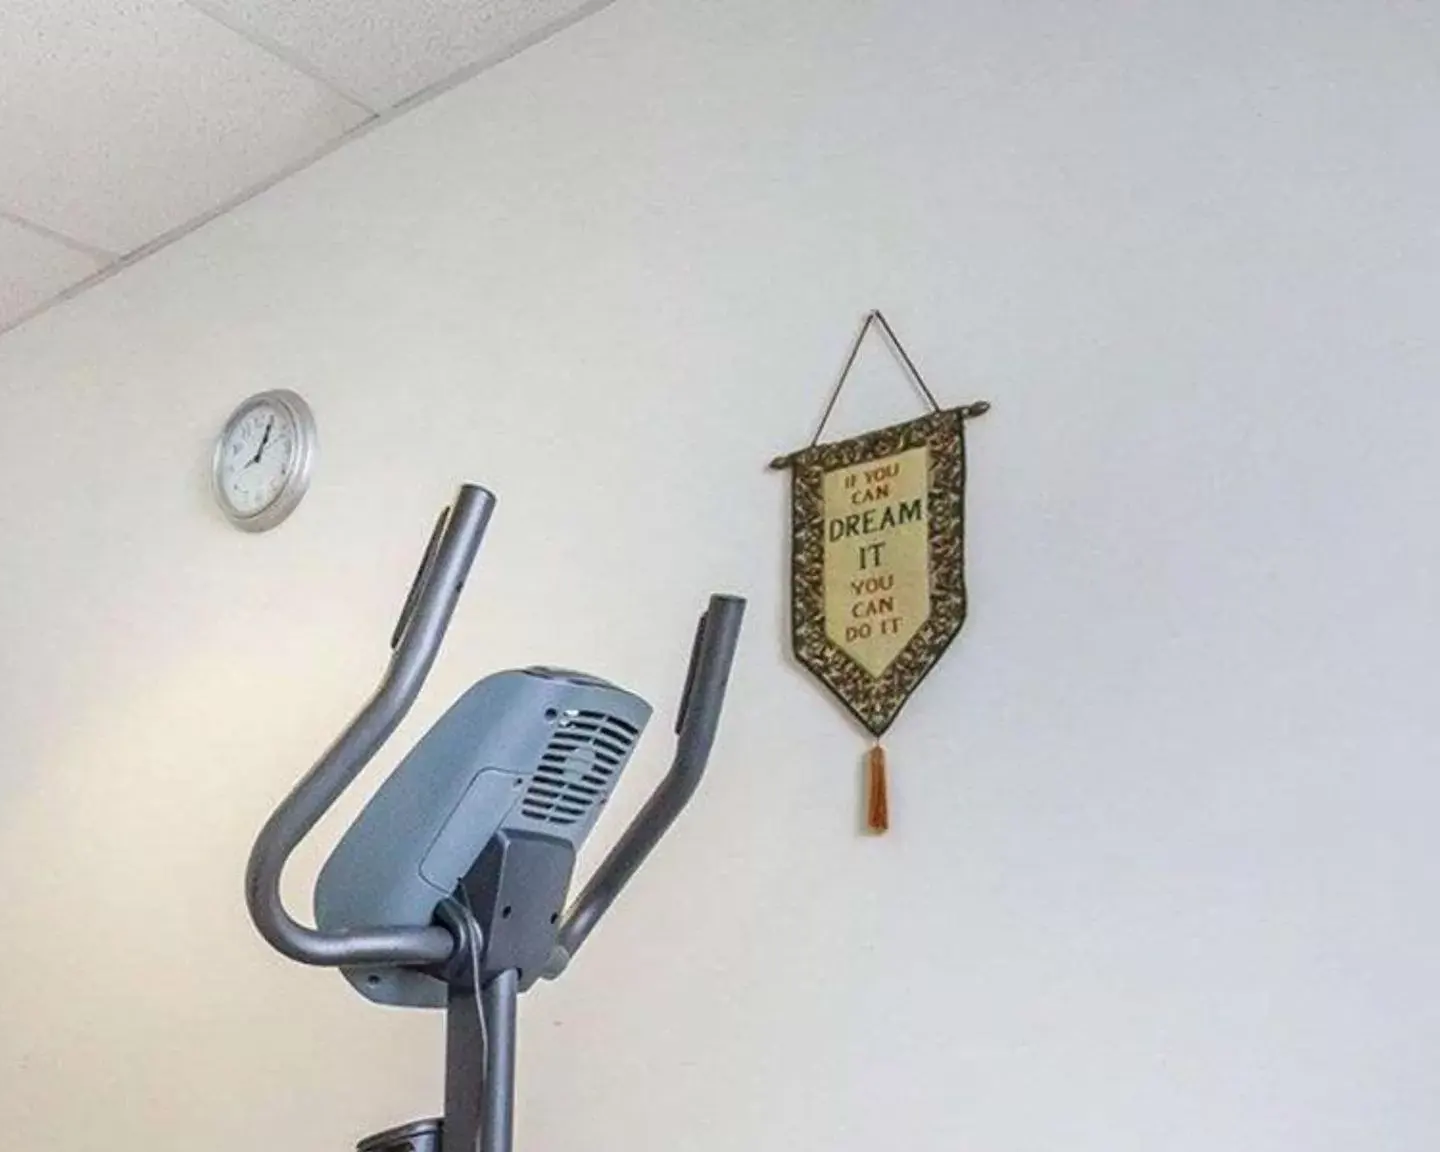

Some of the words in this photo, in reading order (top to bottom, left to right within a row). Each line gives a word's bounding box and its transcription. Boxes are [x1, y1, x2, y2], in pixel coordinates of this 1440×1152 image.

[846, 474, 858, 488] IF
[865, 464, 900, 484] YOU
[851, 485, 889, 505] CAN
[830, 500, 922, 541] DREAM
[859, 544, 885, 569] IT
[852, 576, 893, 595] YOU
[853, 598, 894, 618] CAN
[846, 624, 871, 641] DO
[882, 619, 902, 634] IT
